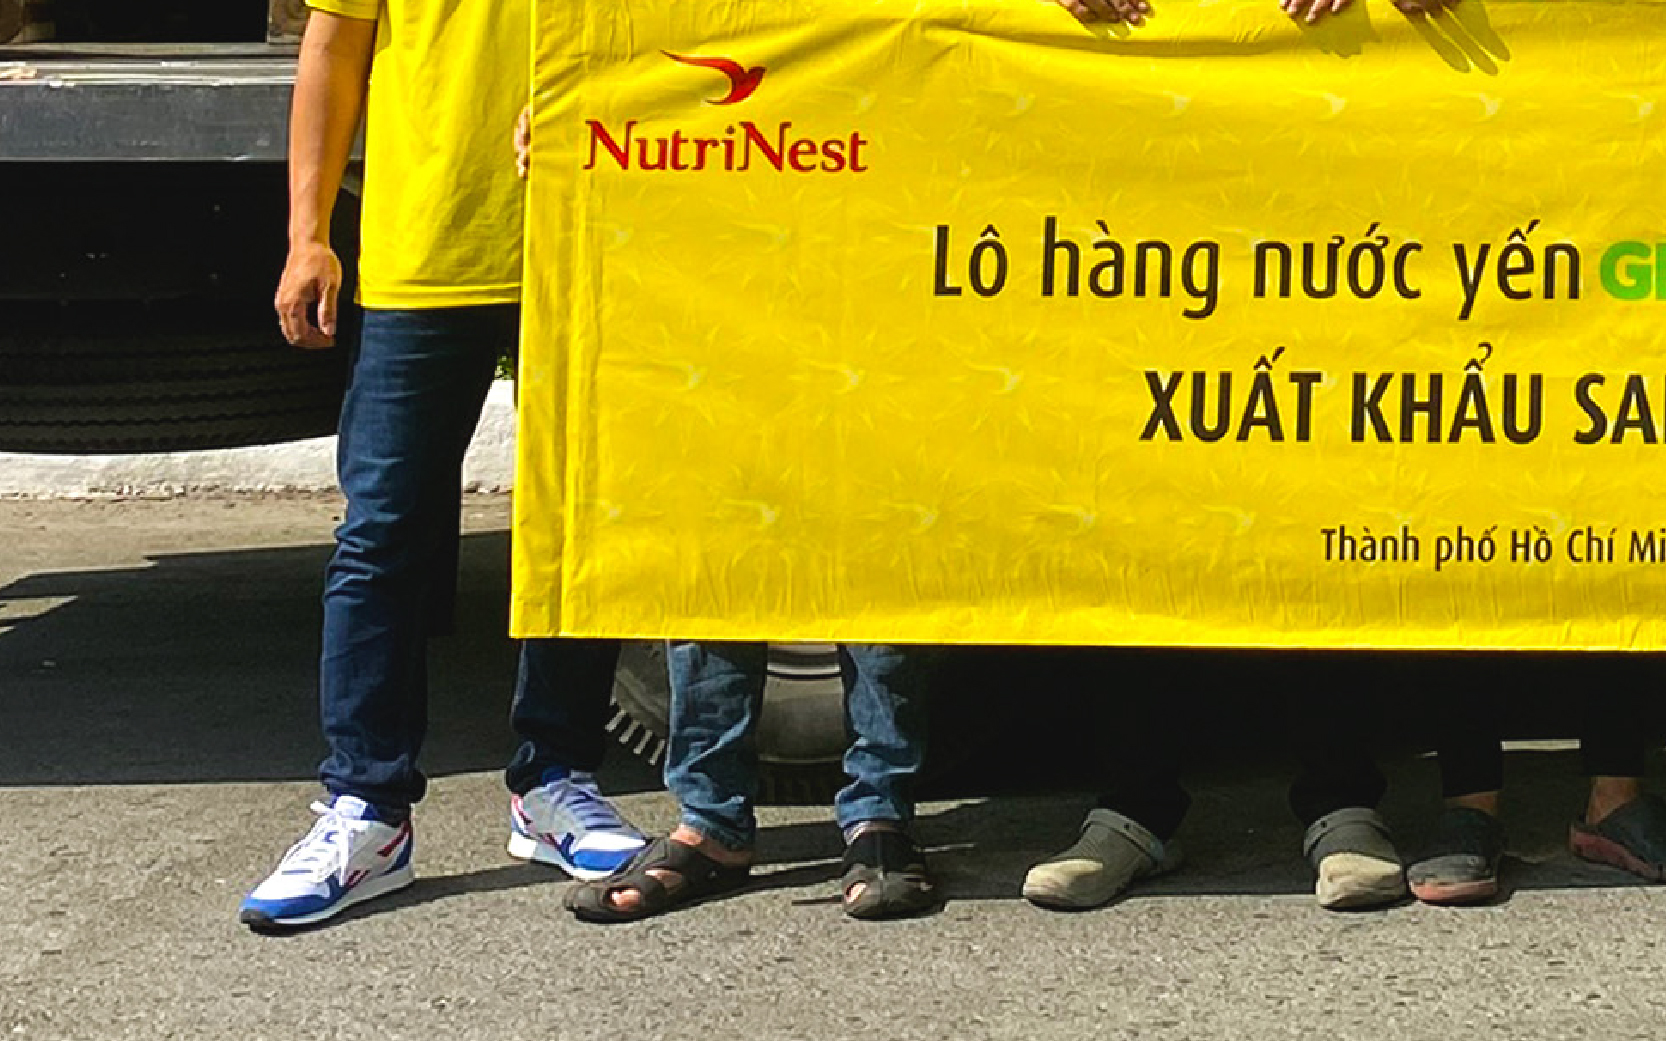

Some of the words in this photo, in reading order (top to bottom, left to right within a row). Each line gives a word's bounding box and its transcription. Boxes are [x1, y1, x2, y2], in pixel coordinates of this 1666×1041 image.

[583, 120, 868, 173] NutriNest
[933, 224, 1008, 297] Lô
[1042, 216, 1219, 319] hàng
[1253, 221, 1424, 300] nước
[1453, 219, 1580, 321] yến
[1140, 346, 1322, 444] XUẤT
[1351, 341, 1543, 445] KHẨU
[1320, 525, 1420, 562] Thành
[1434, 525, 1498, 572] phố
[1511, 525, 1553, 563] Hồ
[1566, 525, 1616, 563] Chí
